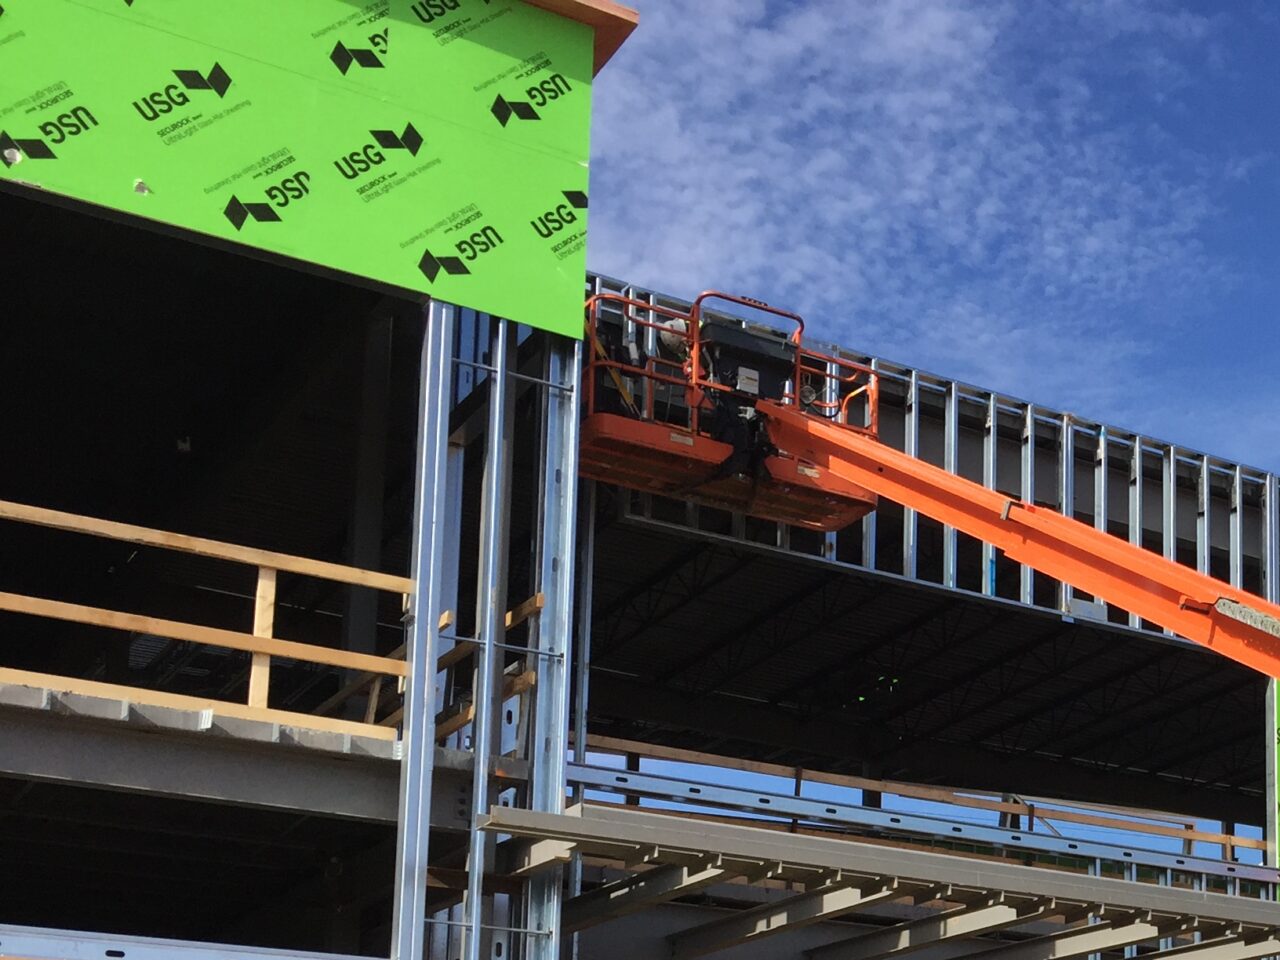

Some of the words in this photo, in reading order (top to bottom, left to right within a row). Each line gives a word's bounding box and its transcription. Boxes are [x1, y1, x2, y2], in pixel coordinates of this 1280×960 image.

[132, 84, 190, 121] USG
[525, 73, 573, 107] USG
[38, 106, 99, 144] USG
[333, 144, 386, 180] USG
[264, 170, 310, 208] USG
[530, 203, 578, 238] USG
[455, 225, 504, 261] USG
